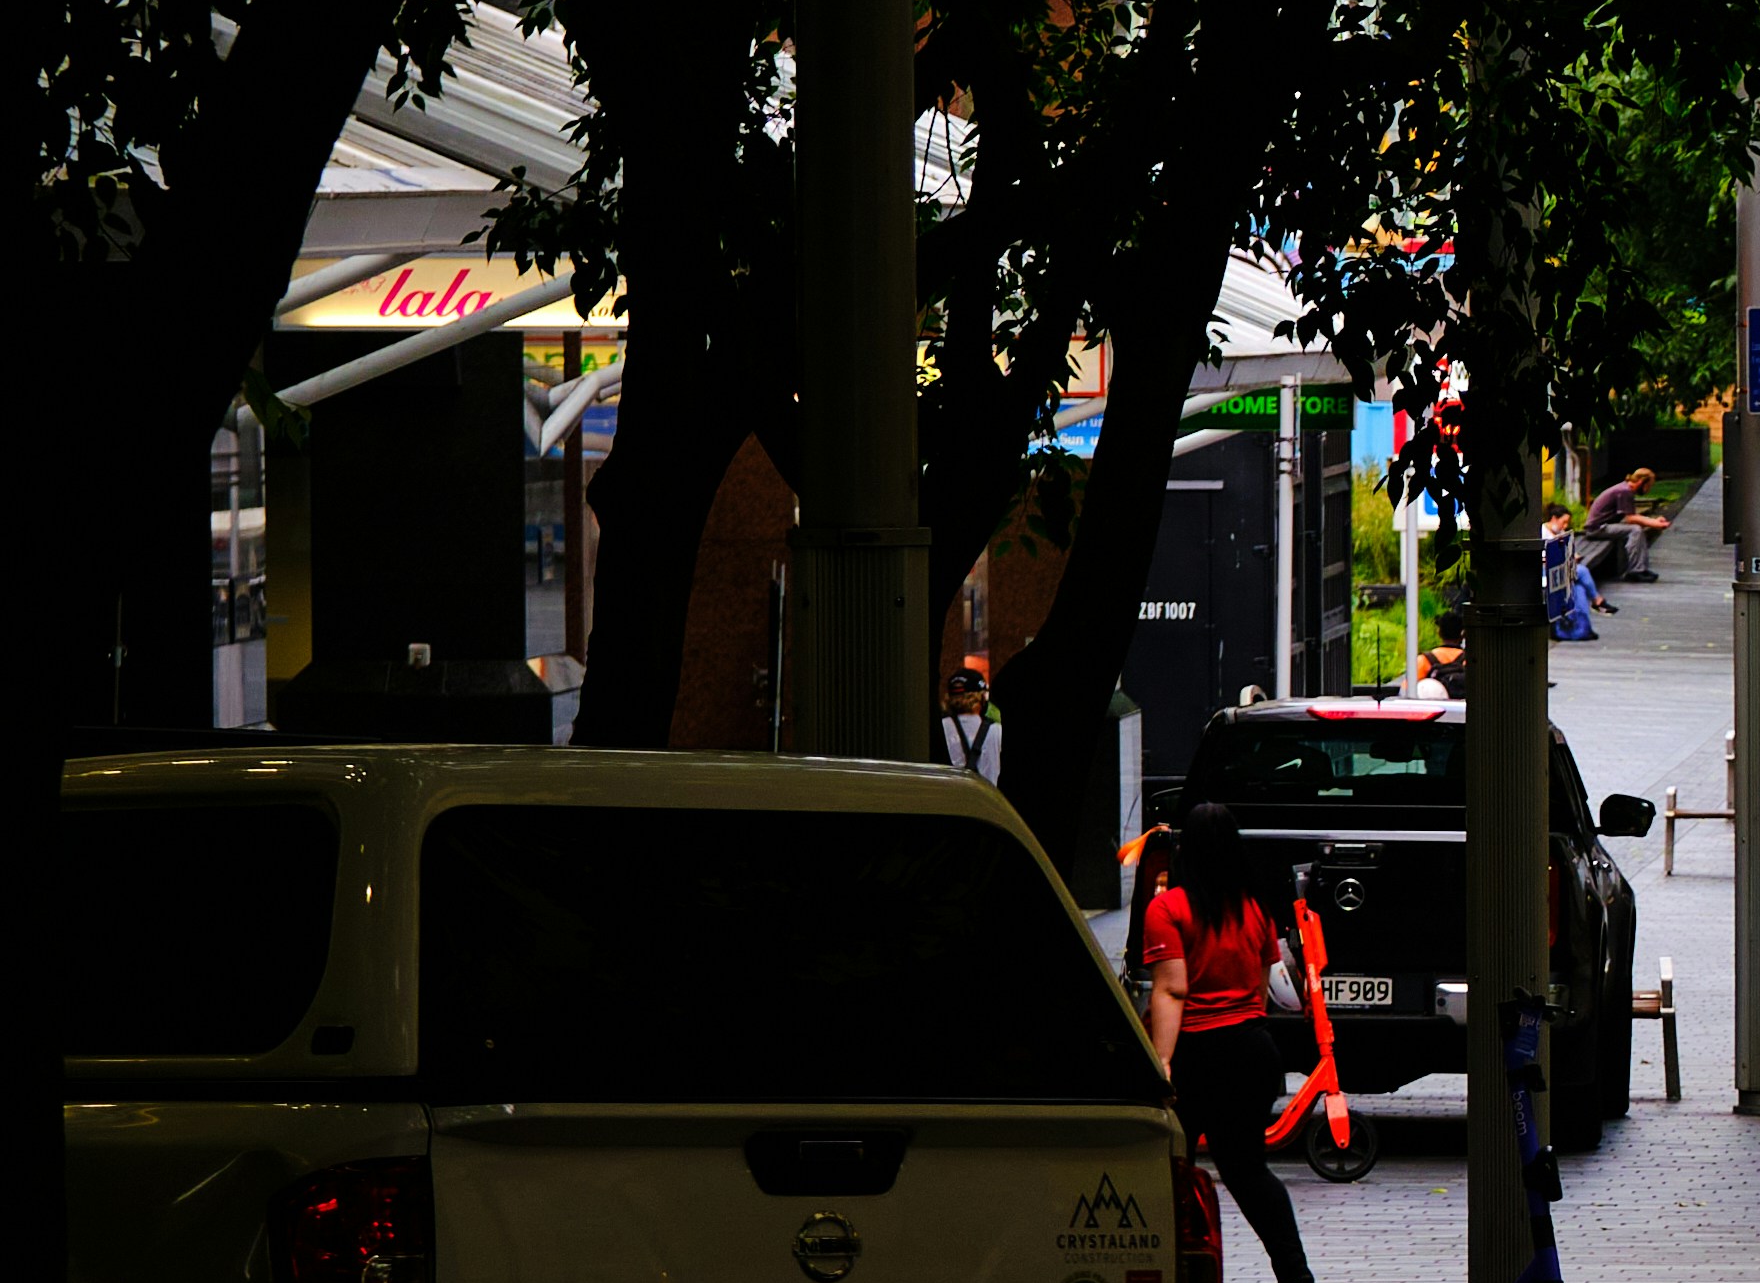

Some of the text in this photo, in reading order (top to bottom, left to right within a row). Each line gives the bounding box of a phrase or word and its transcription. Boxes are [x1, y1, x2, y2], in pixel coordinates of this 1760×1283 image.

[1211, 395, 1350, 415] HOME TORE
[1323, 980, 1390, 1002] HF909
[1511, 1089, 1529, 1137] beam
[1056, 1233, 1161, 1250] CRYSTALAND
